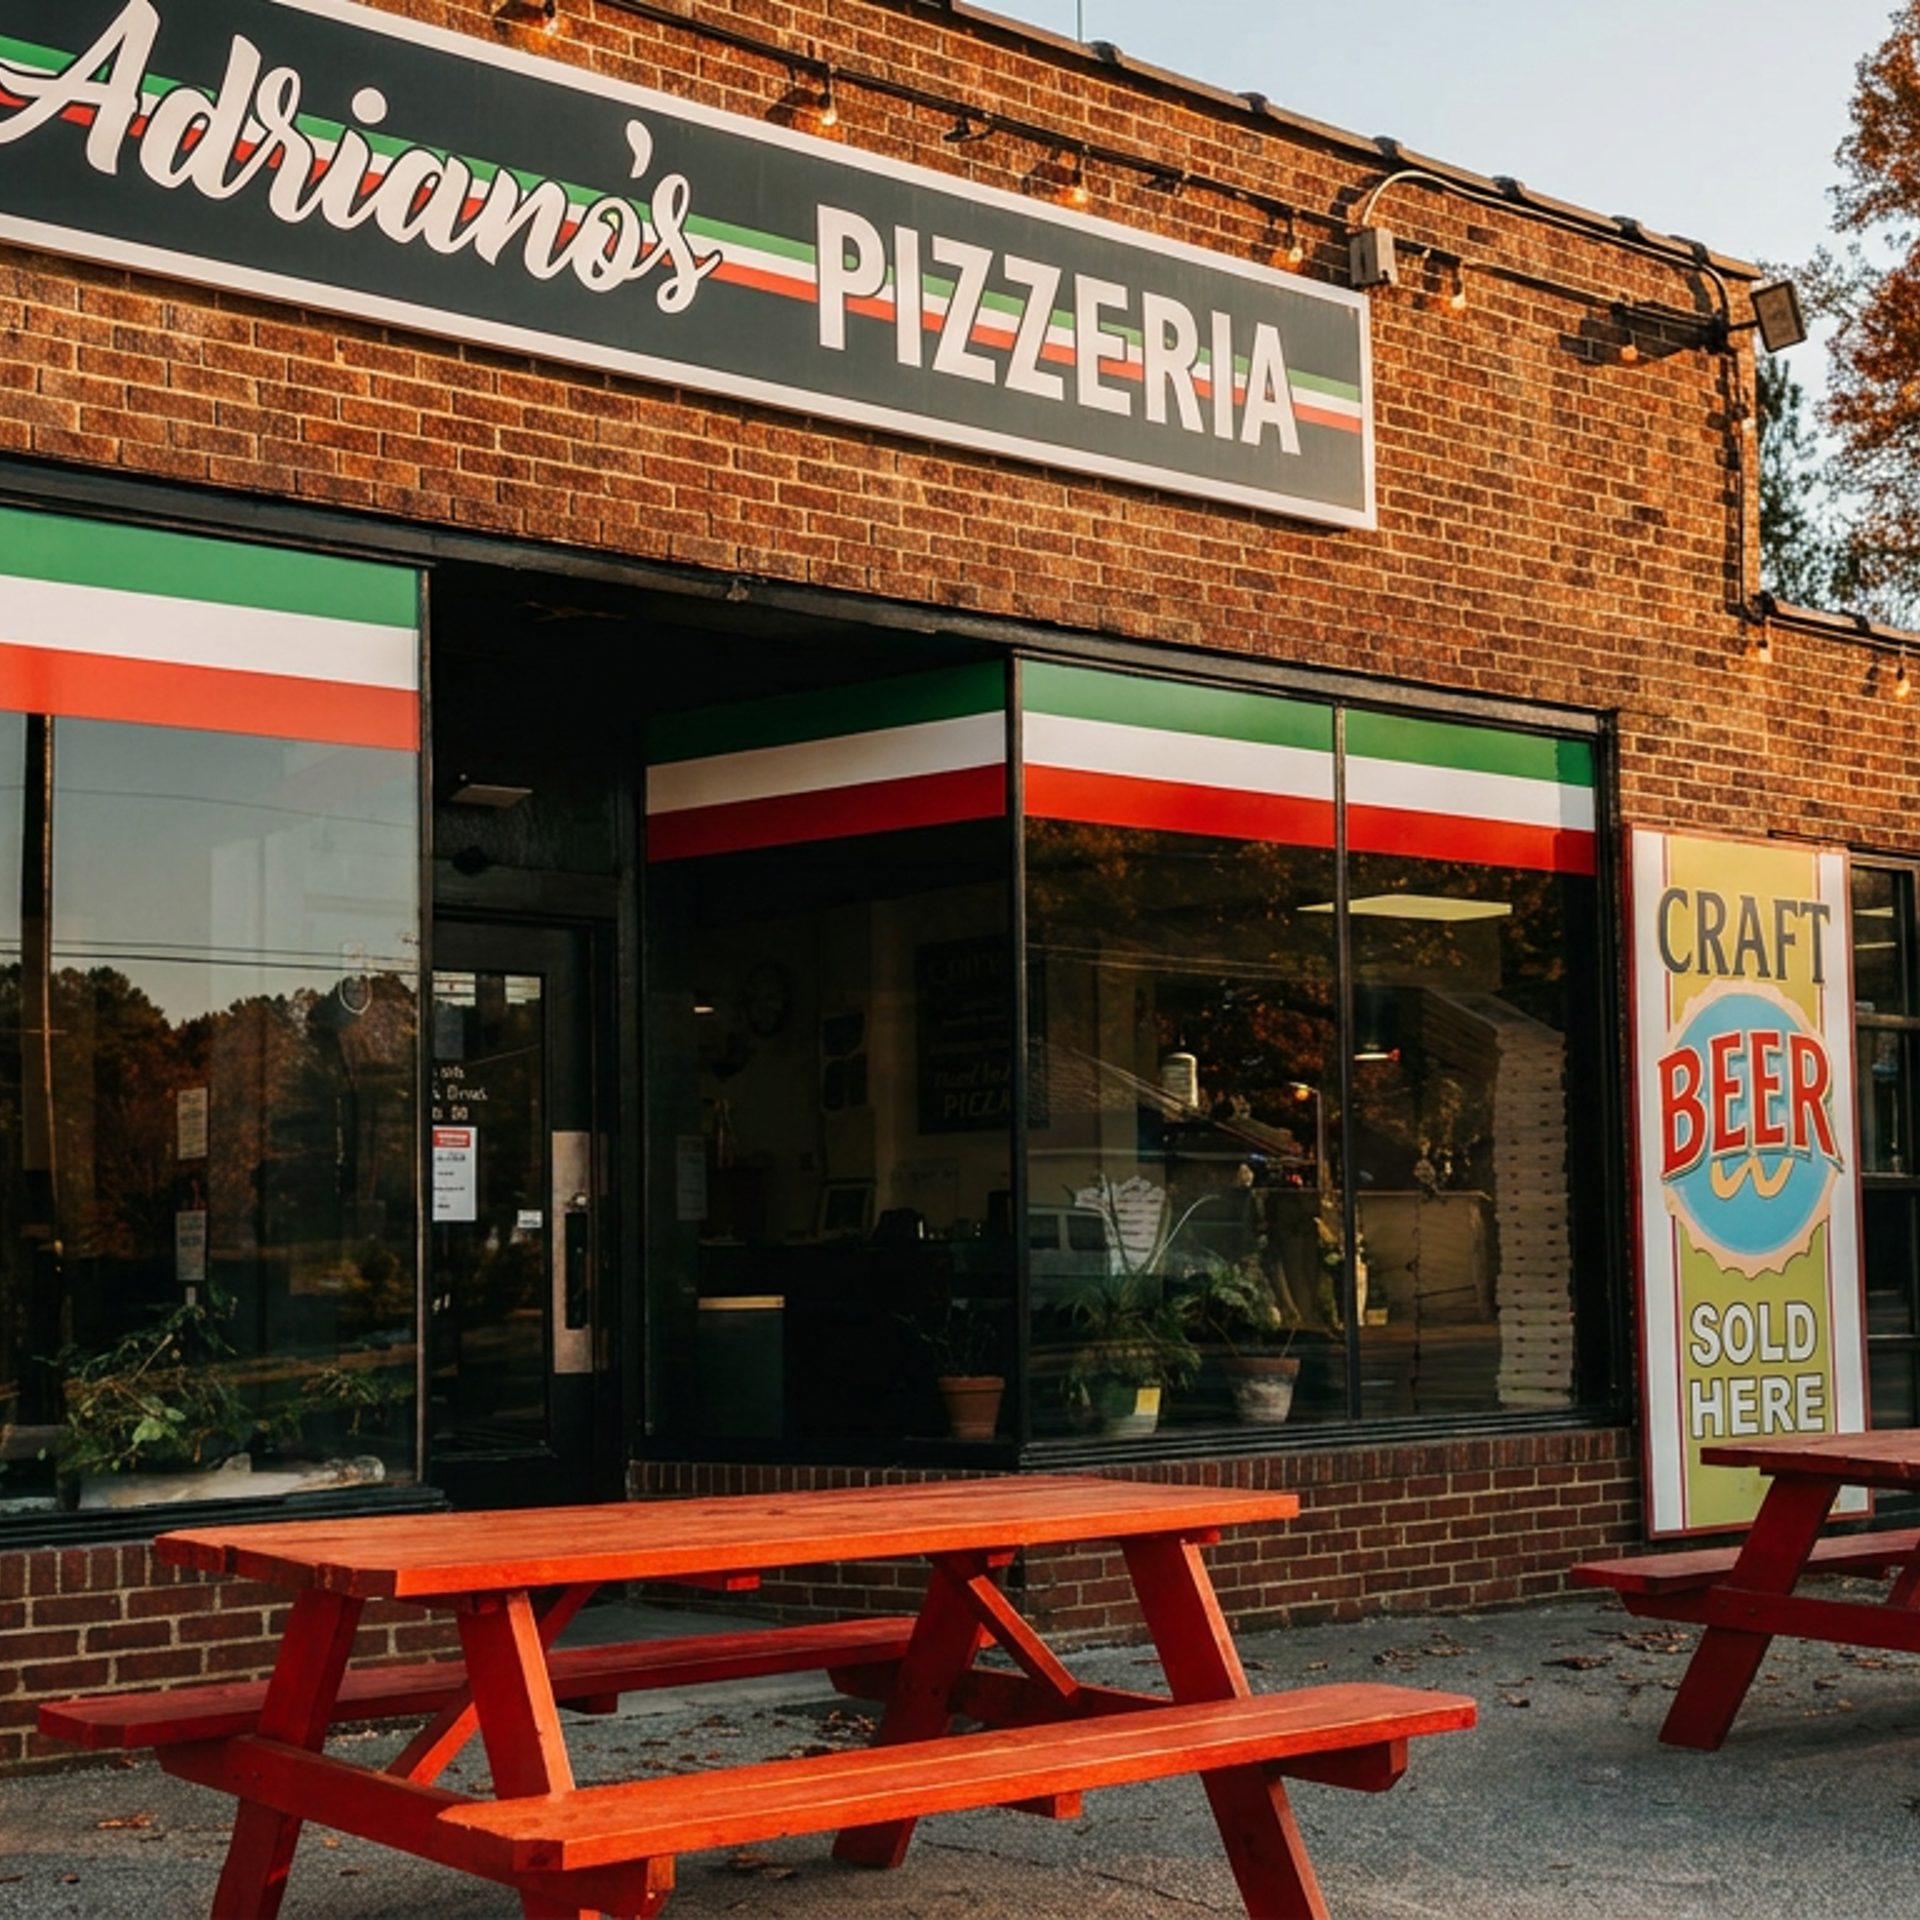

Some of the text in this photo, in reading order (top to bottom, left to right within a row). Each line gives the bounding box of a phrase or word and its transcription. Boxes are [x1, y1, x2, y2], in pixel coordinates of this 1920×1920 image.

[0, 0, 1301, 456] Adriano's PIZZERIA
[1658, 887, 1832, 984] CRAFT
[1657, 1030, 1843, 1182] BEER
[1690, 1302, 1818, 1368] SOLD
[1690, 1372, 1826, 1439] HERE
